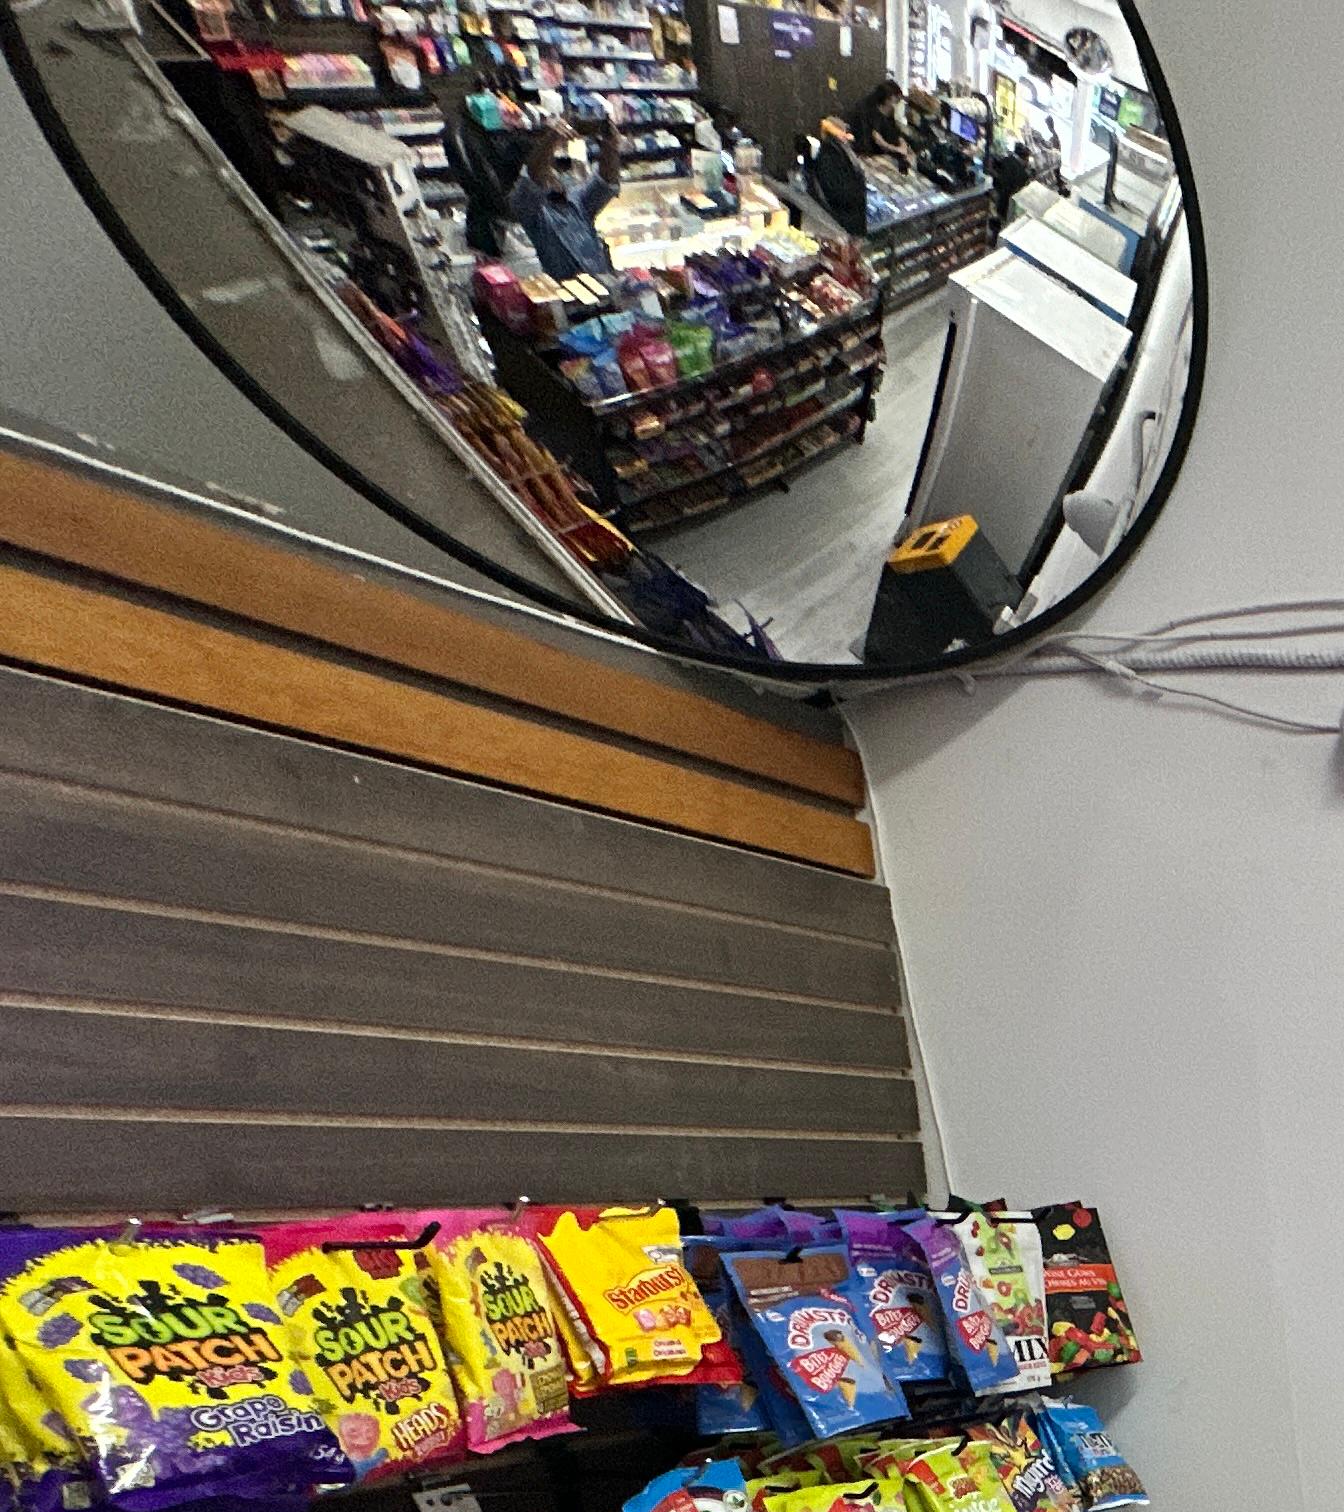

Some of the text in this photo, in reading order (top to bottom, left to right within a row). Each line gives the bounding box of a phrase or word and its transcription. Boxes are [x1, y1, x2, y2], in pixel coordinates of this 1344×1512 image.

[484, 1287, 538, 1321] SOUR
[89, 1304, 249, 1345] SOUR
[314, 1312, 416, 1362] SOUR
[492, 1311, 553, 1349] PATCH
[109, 1331, 284, 1383] PATCH
[196, 1365, 264, 1388] Kids
[326, 1341, 437, 1399] PATCH
[190, 1394, 287, 1431] Grape
[228, 1409, 326, 1448] Raisin
[392, 1403, 450, 1449] HEADS
